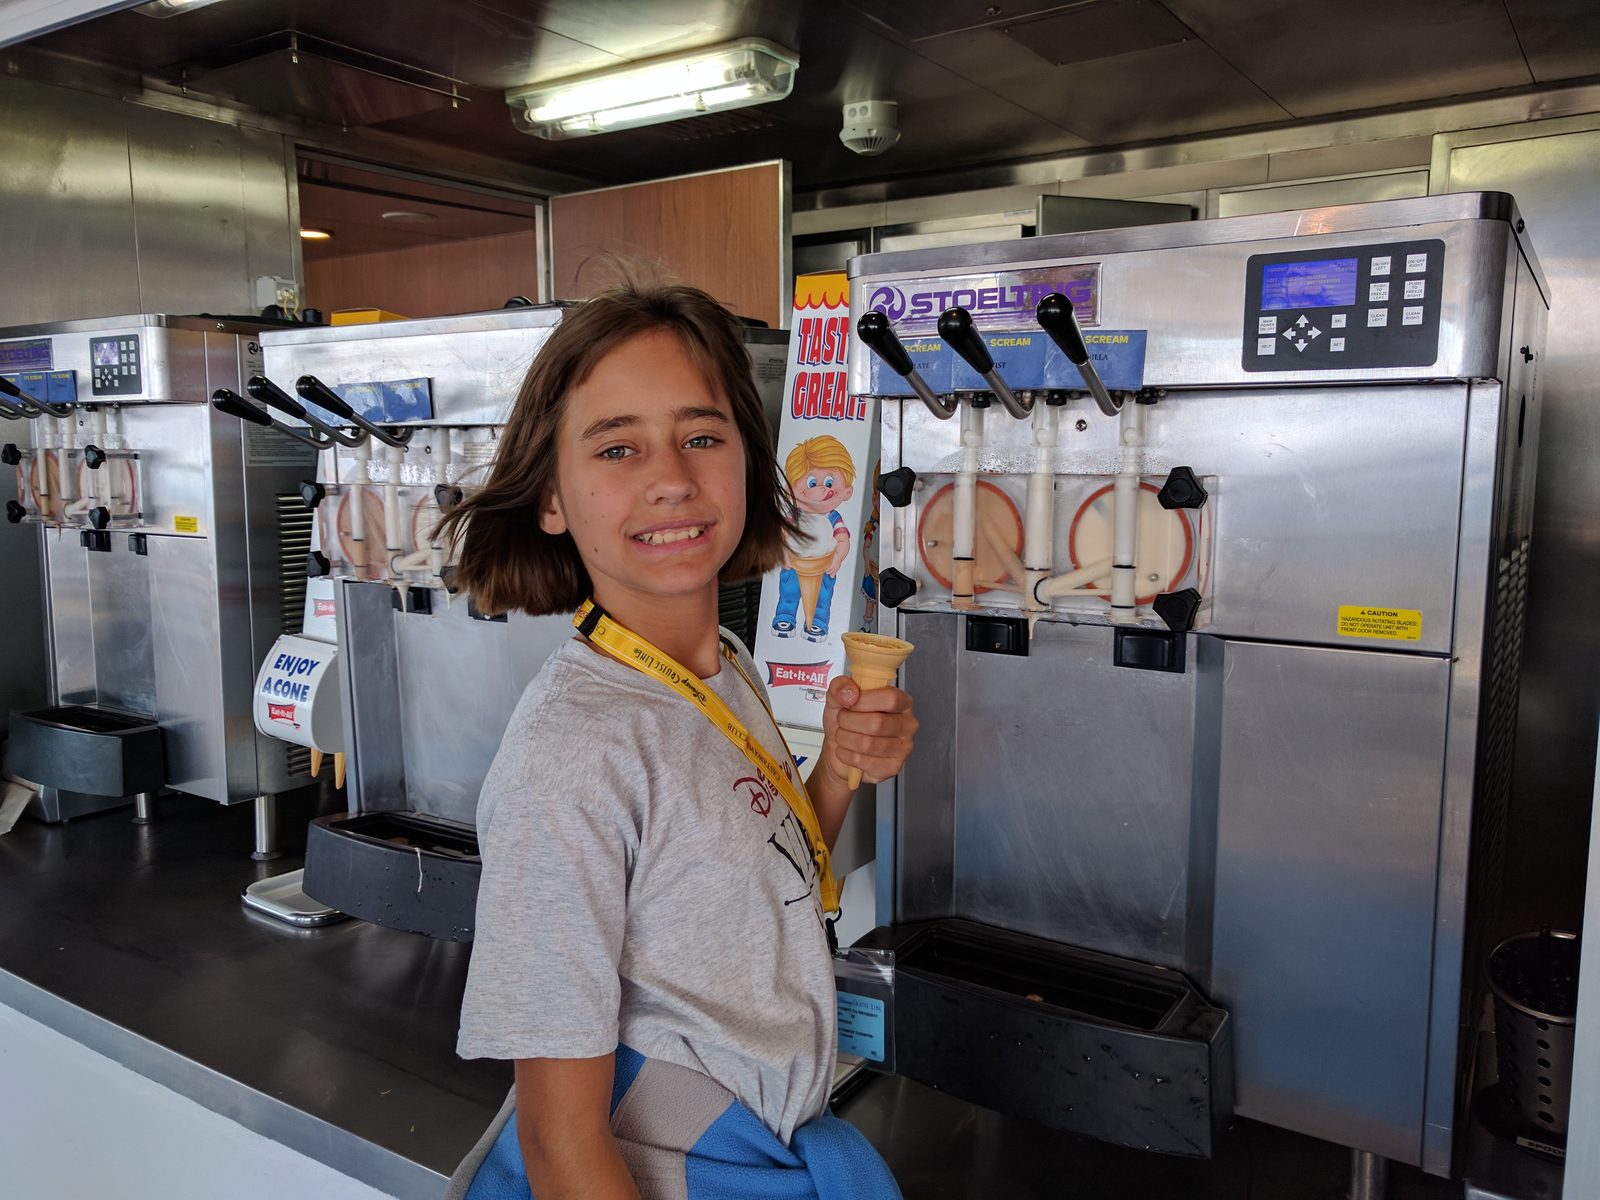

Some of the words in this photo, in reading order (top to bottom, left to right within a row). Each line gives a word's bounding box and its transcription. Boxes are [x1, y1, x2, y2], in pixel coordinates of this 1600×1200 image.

[797, 316, 849, 367] TAST
[904, 343, 942, 353] SCREAM
[990, 337, 1032, 347] SCREAM
[1084, 335, 1129, 344] SCREAM
[273, 653, 320, 677] ENJOY
[261, 676, 273, 694] A
[273, 678, 310, 703] CONE
[727, 722, 749, 742] CLUB
